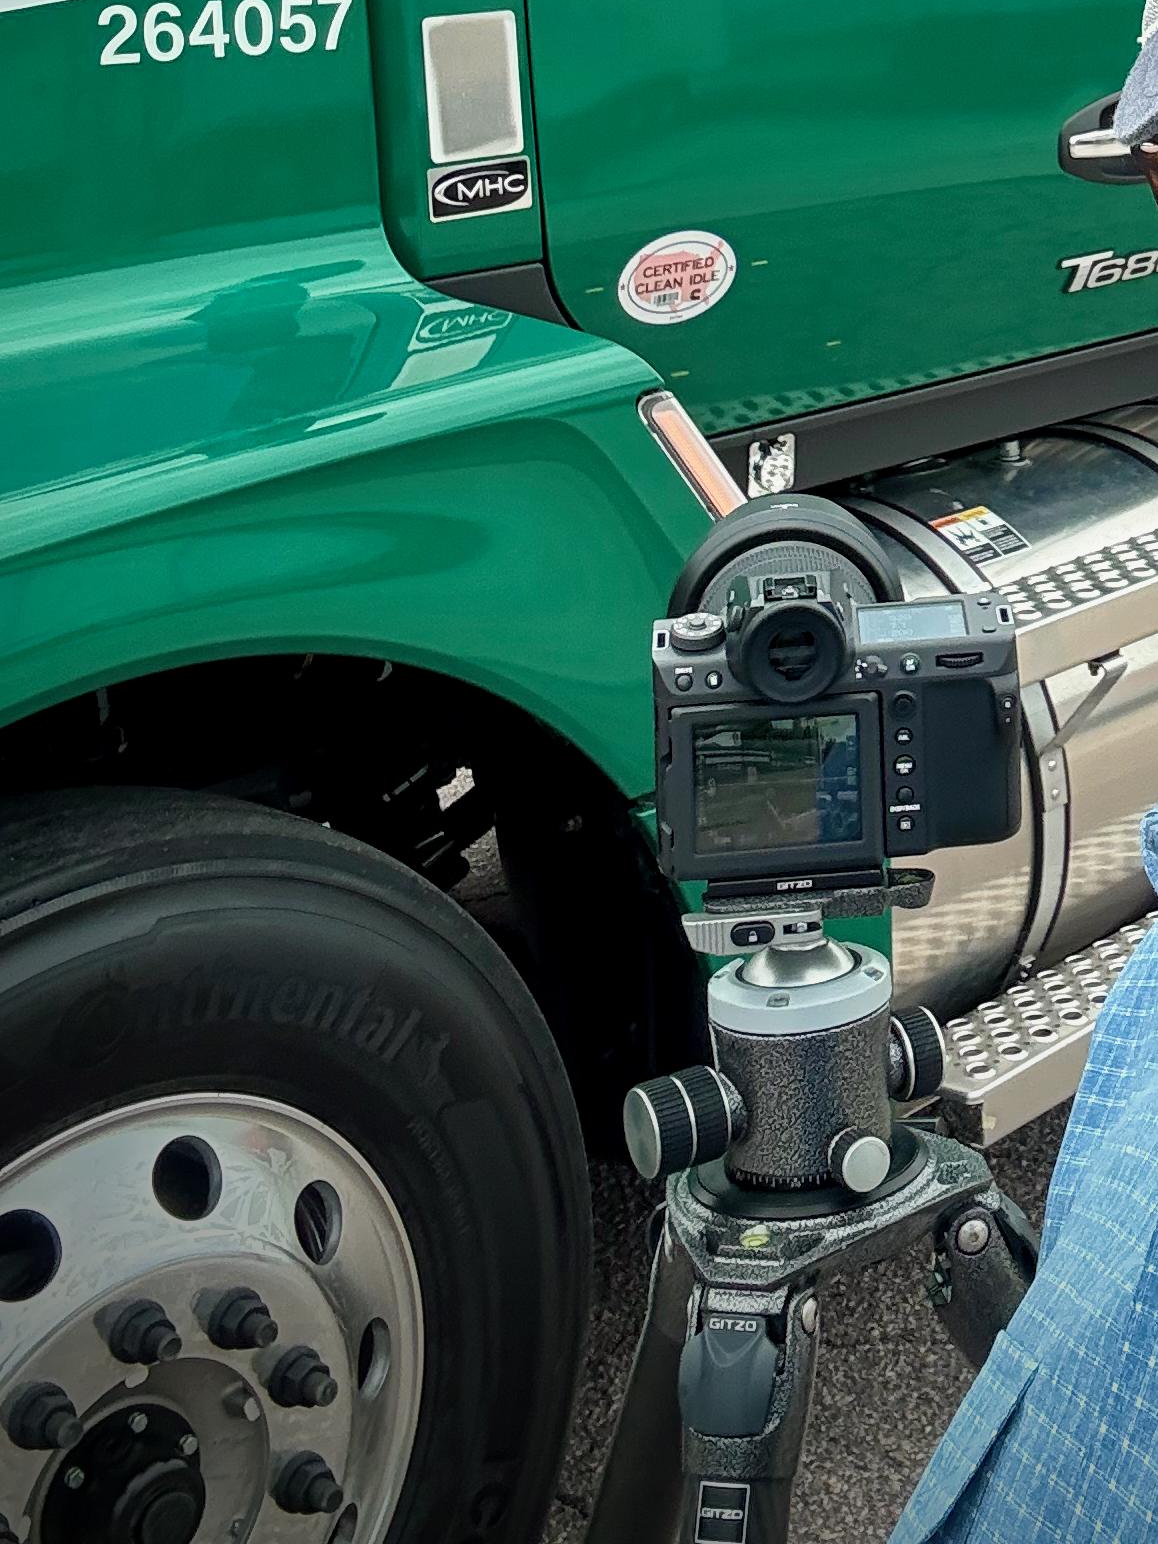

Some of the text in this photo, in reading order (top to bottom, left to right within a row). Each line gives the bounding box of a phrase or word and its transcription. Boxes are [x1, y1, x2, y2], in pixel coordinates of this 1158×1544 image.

[457, 173, 525, 201] MHC
[643, 256, 715, 279] CERTIFIED
[635, 269, 721, 295] CLEAN IDLE
[54, 960, 424, 1070] Cntinental
[708, 1317, 757, 1332] GITZO
[701, 1507, 744, 1520] GITZO
